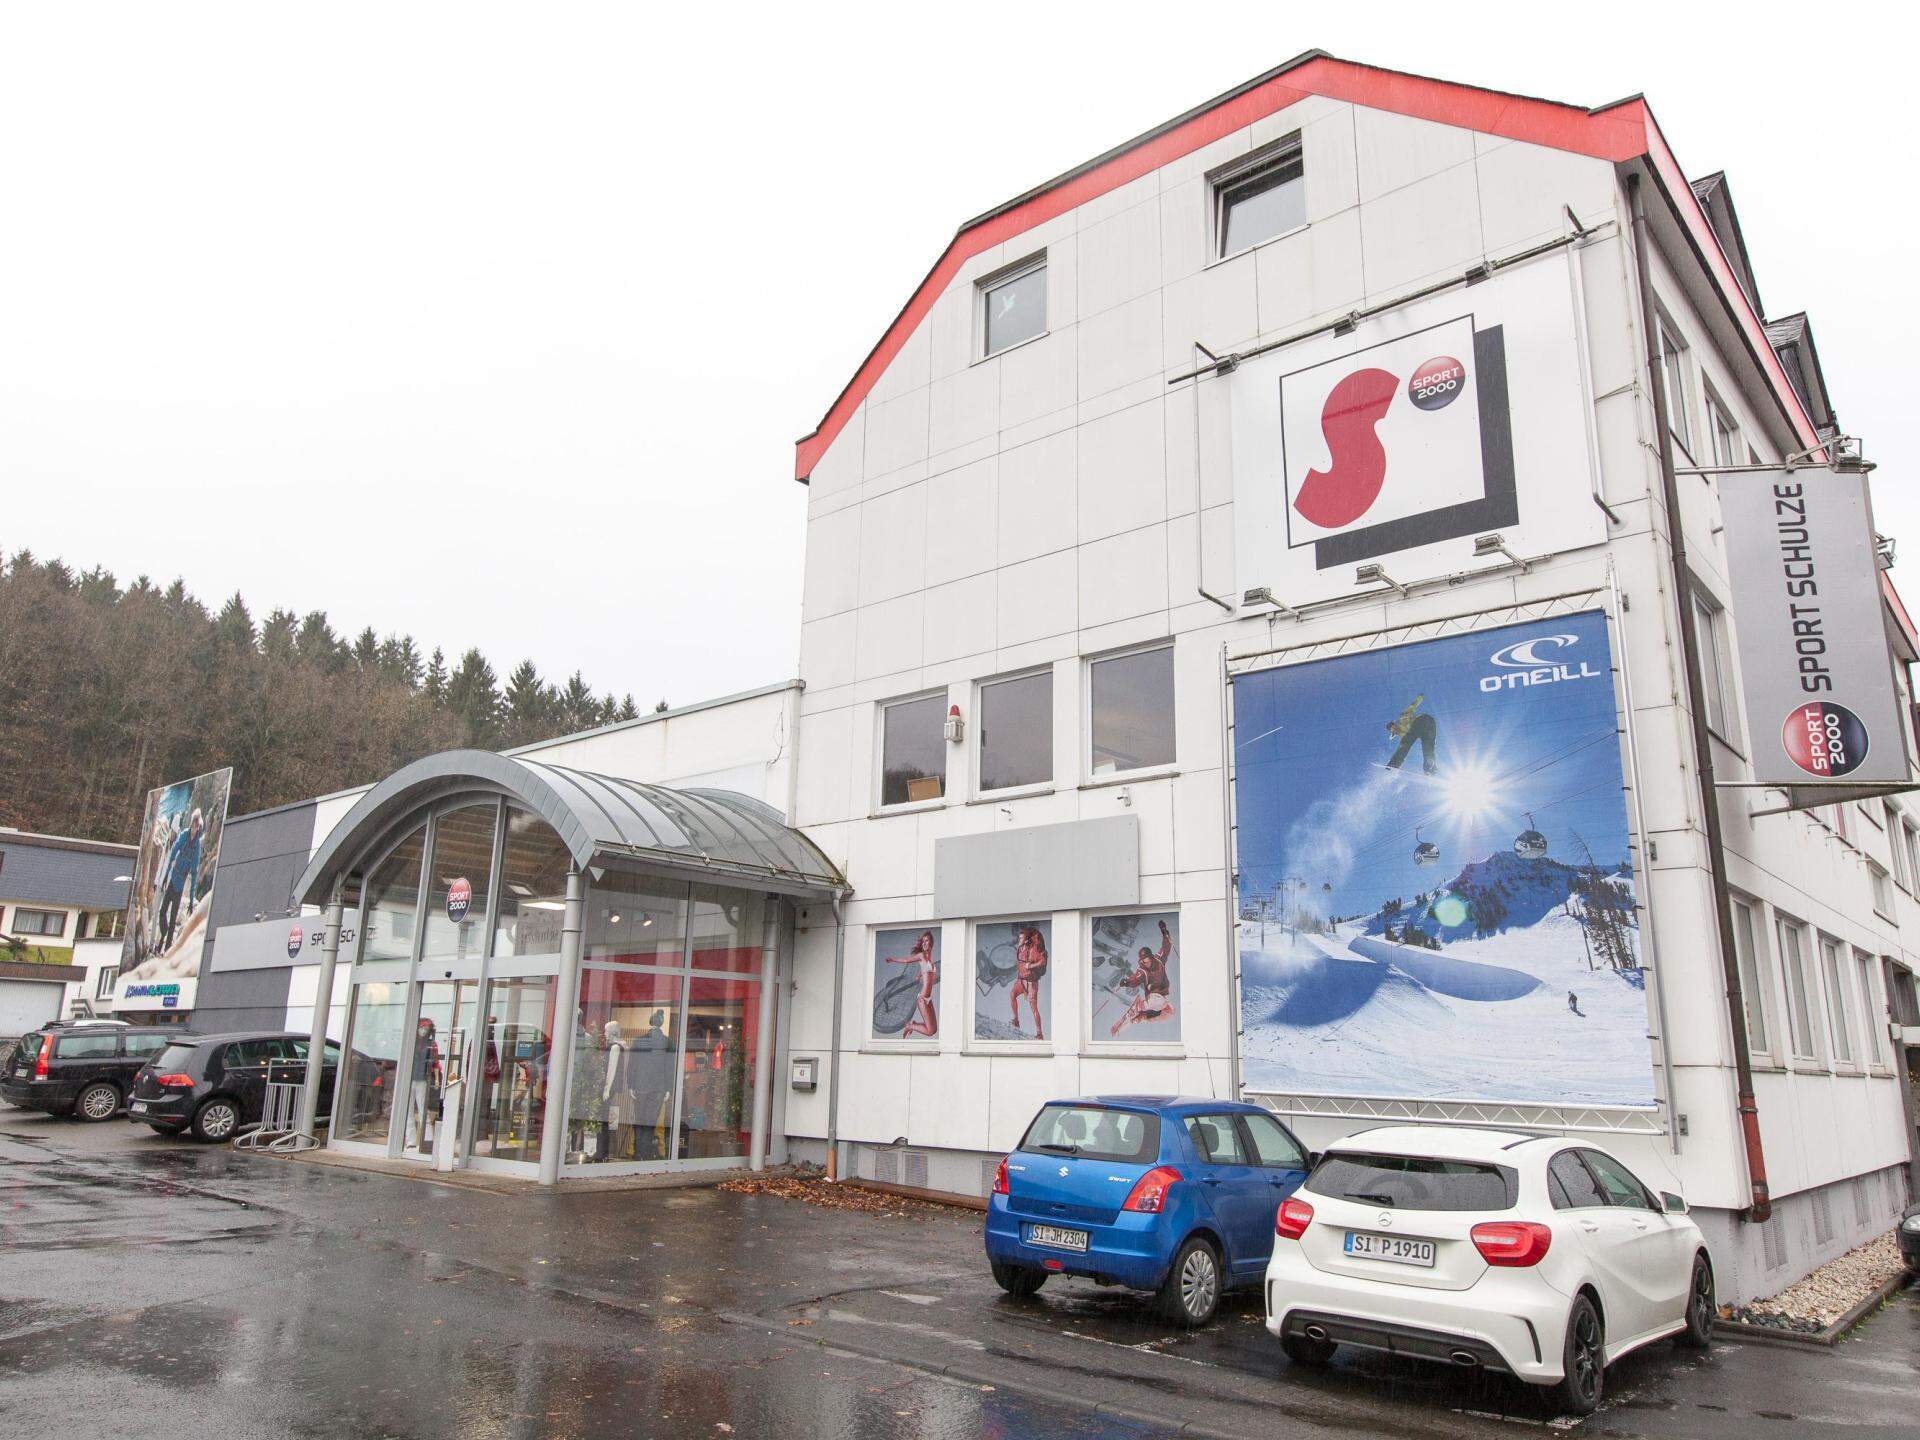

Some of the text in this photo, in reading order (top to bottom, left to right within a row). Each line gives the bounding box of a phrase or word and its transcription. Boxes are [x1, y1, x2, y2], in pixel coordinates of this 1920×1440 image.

[1413, 367, 1459, 389] SPORT
[1417, 380, 1456, 399] 2000
[1773, 483, 1832, 692] SPORT SCHULZE
[1805, 709, 1828, 769] SPORT
[1824, 713, 1845, 764] 2000
[449, 890, 469, 901] SPORT
[449, 900, 466, 910] 2000
[1034, 1226, 1086, 1246] SI JH 2304
[1354, 1236, 1431, 1260] SI P 1910
